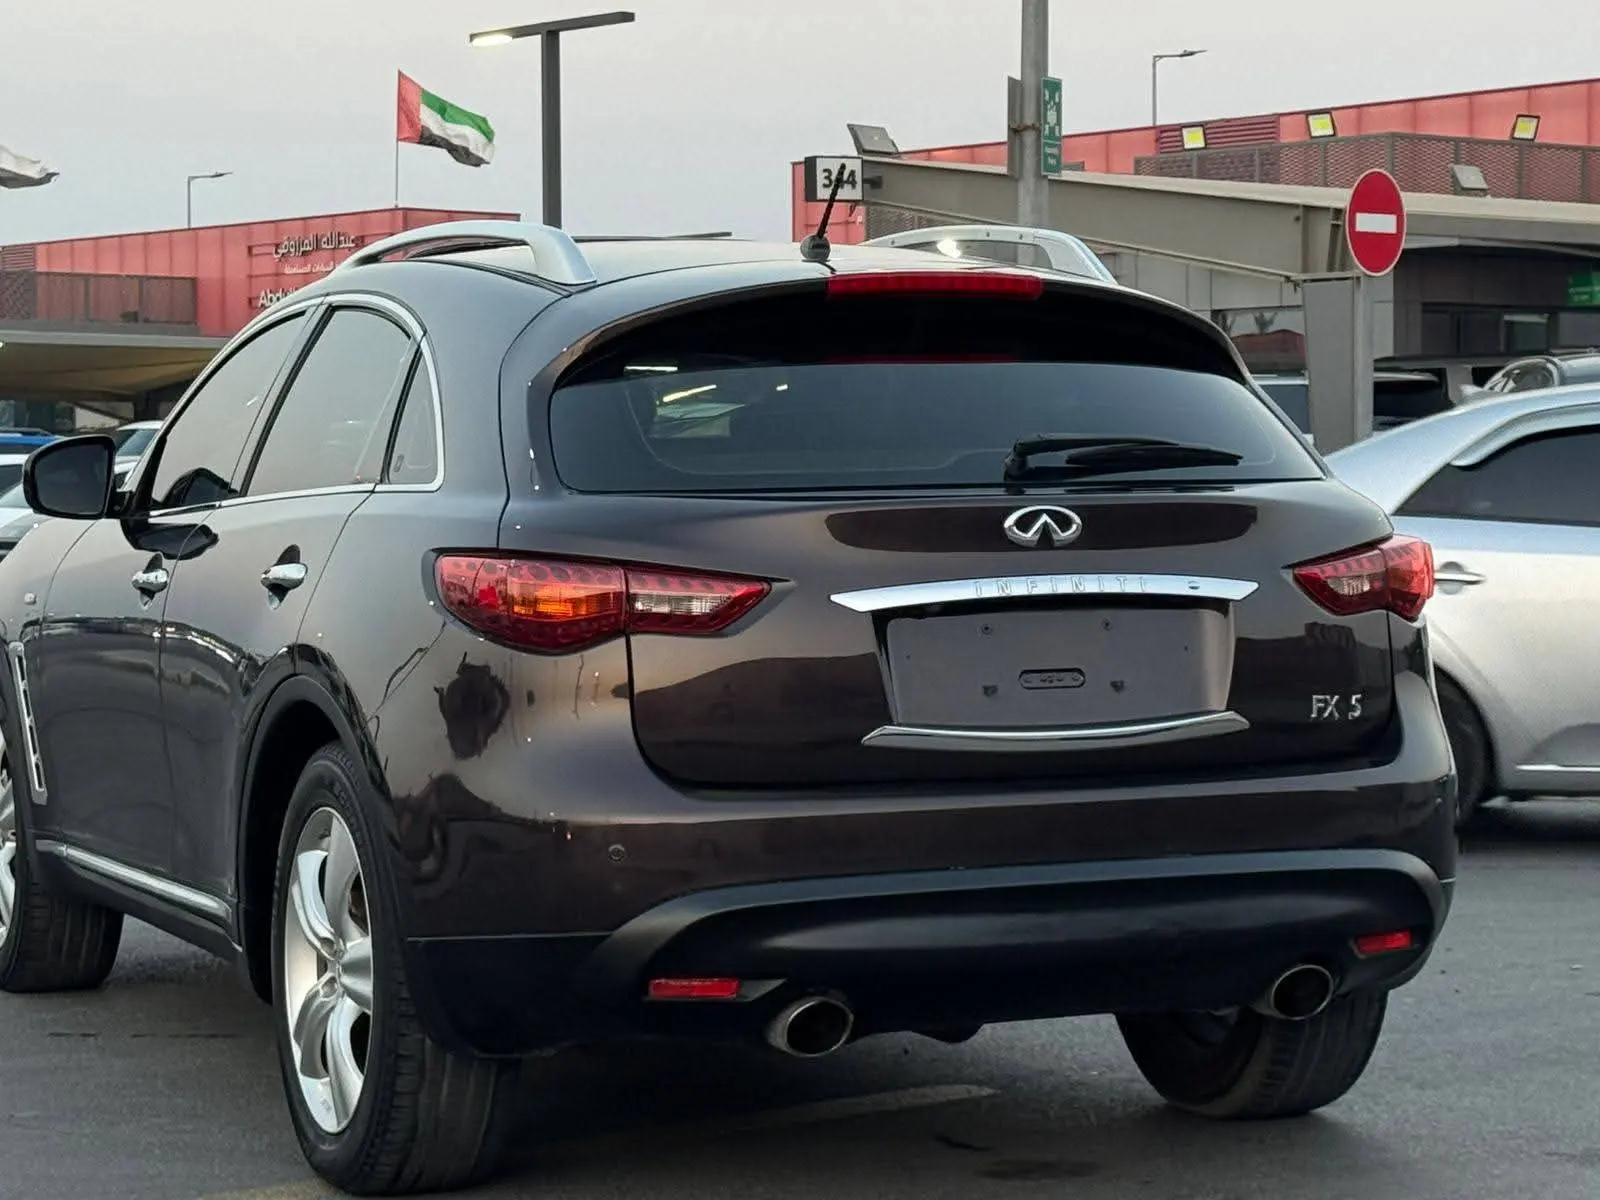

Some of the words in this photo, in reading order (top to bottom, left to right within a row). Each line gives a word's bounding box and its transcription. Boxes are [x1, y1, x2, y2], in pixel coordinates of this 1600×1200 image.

[973, 575, 1147, 598] INFINITI
[1310, 694, 1340, 720] FX
[1348, 694, 1362, 720] 5
